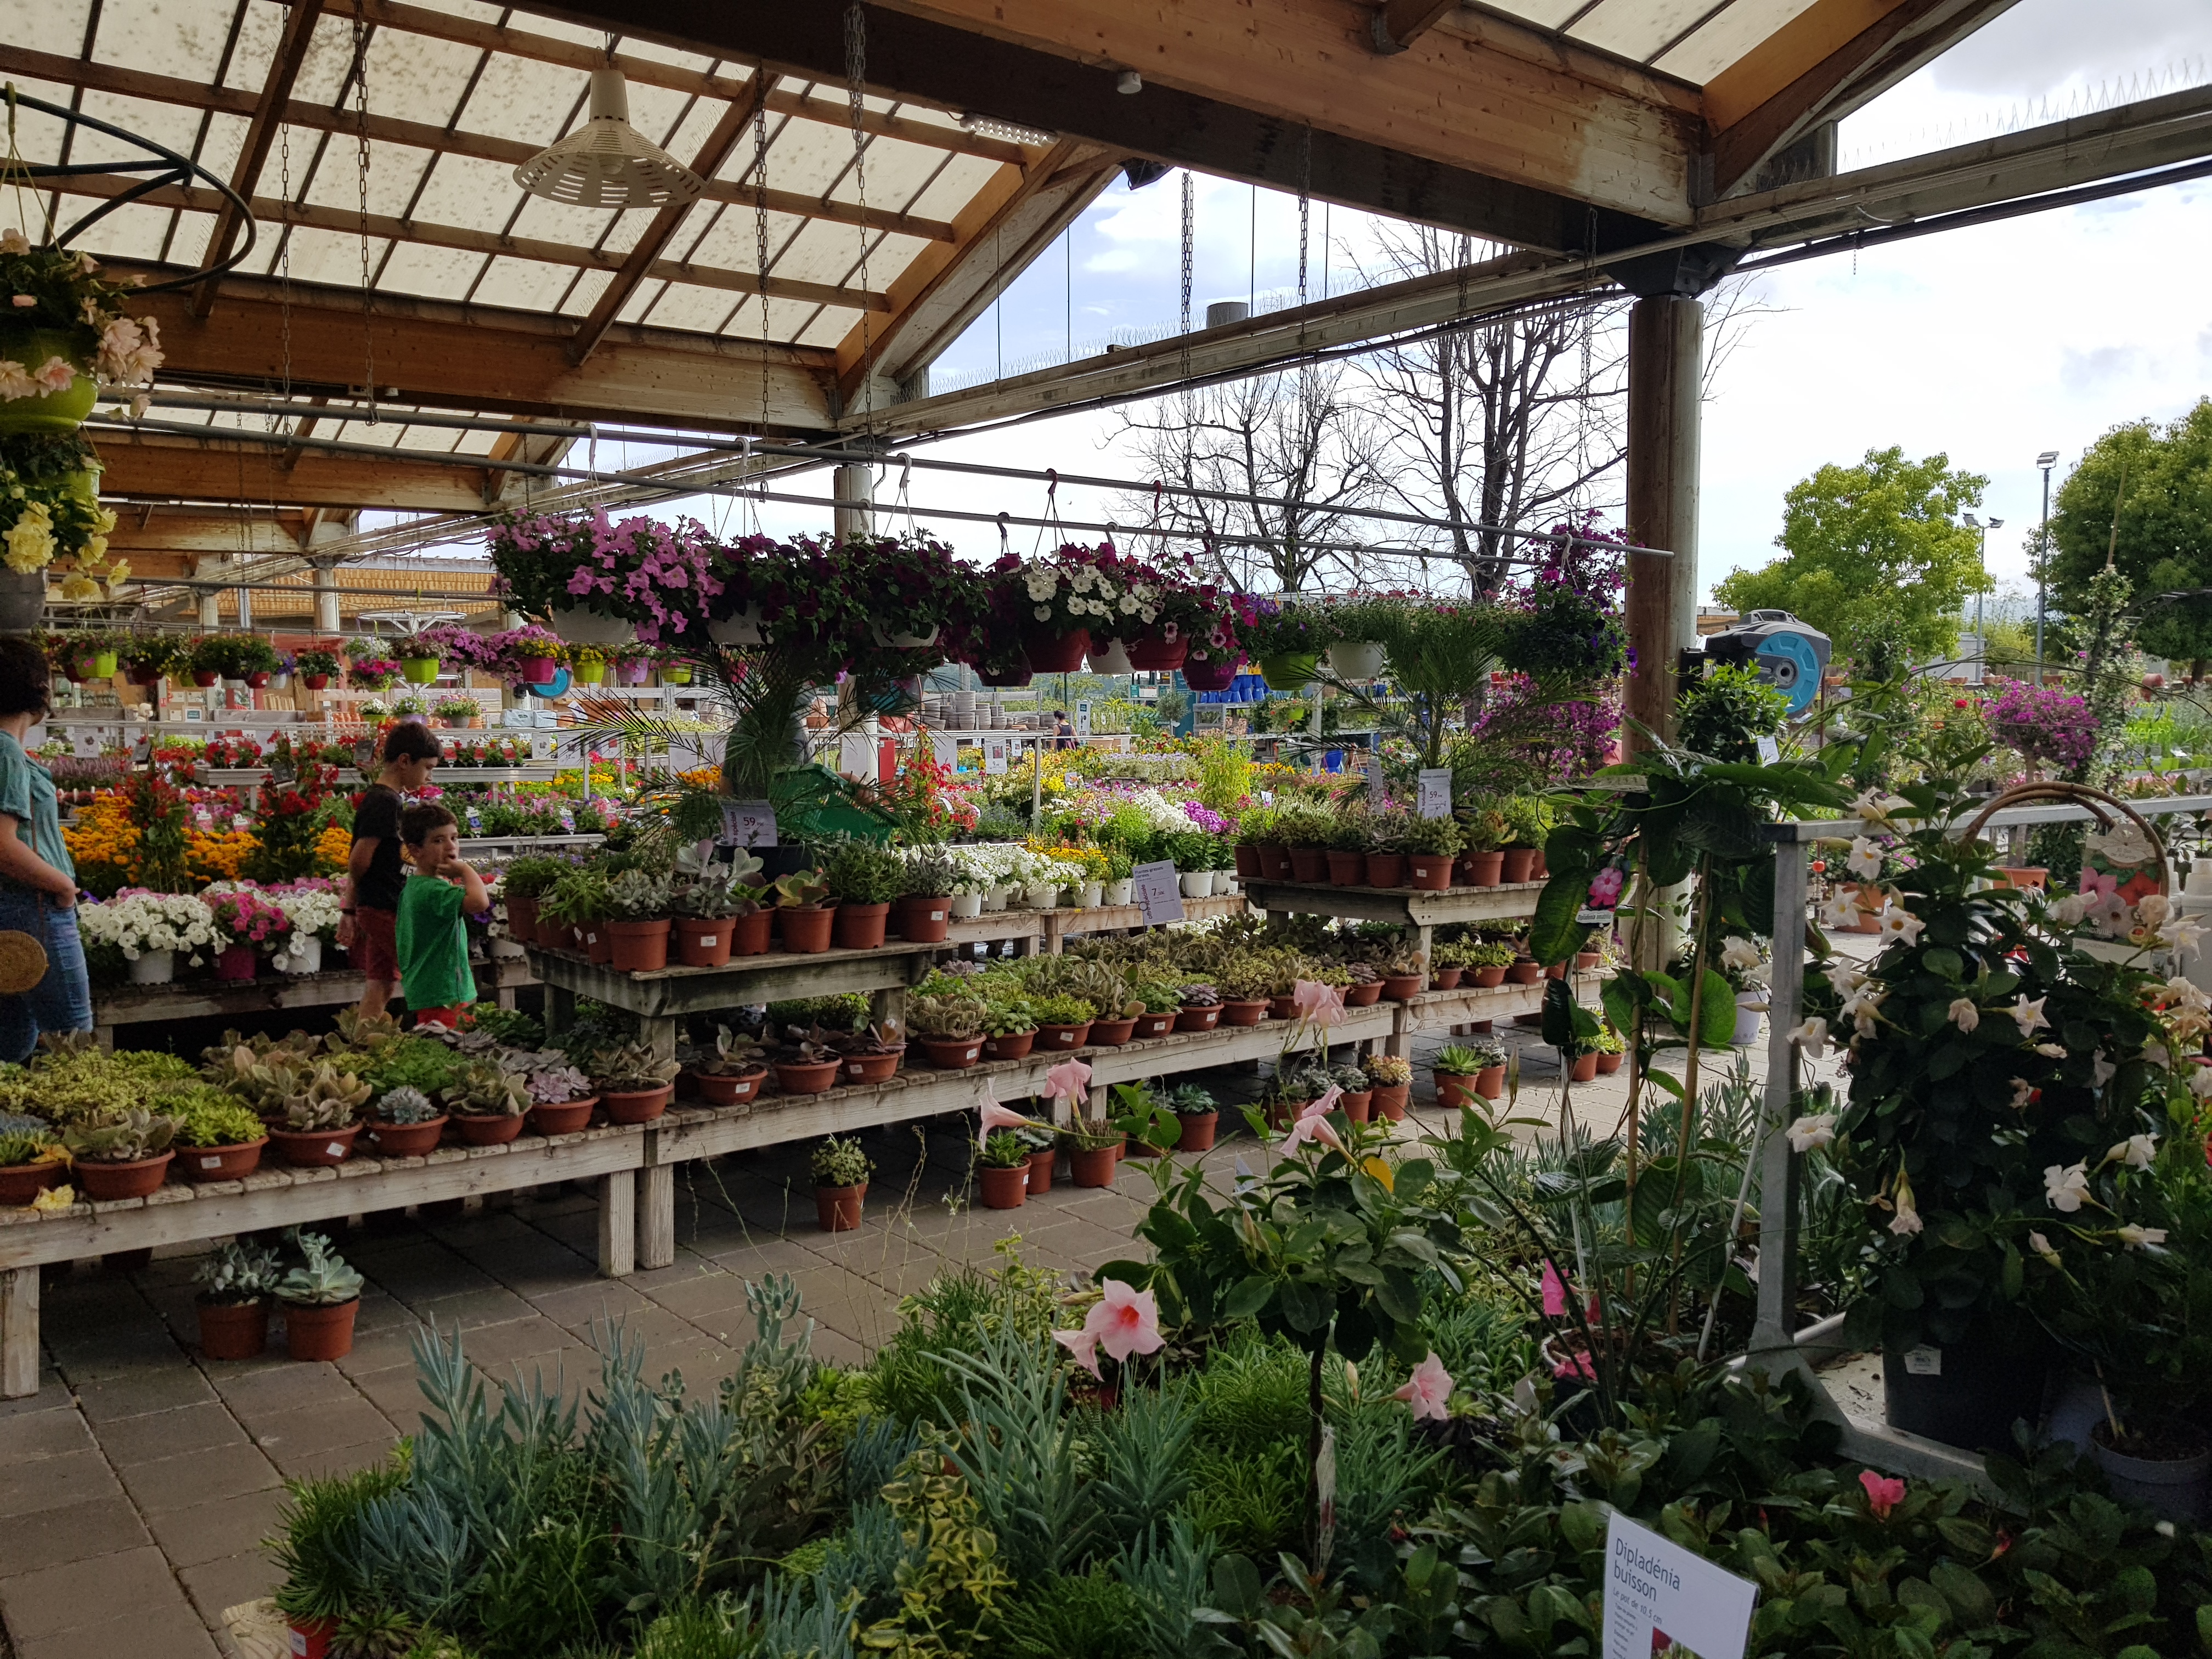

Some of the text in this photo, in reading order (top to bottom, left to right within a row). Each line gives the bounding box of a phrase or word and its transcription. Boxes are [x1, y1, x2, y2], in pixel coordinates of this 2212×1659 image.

[1614, 1559, 1657, 1601] buisson
[1616, 1537, 1680, 1592] Dipladénia
[1613, 1586, 1620, 1598] Le
[1620, 1593, 1630, 1605] pot
[1631, 1599, 1639, 1610] de
[1652, 1614, 1662, 1624] cm
